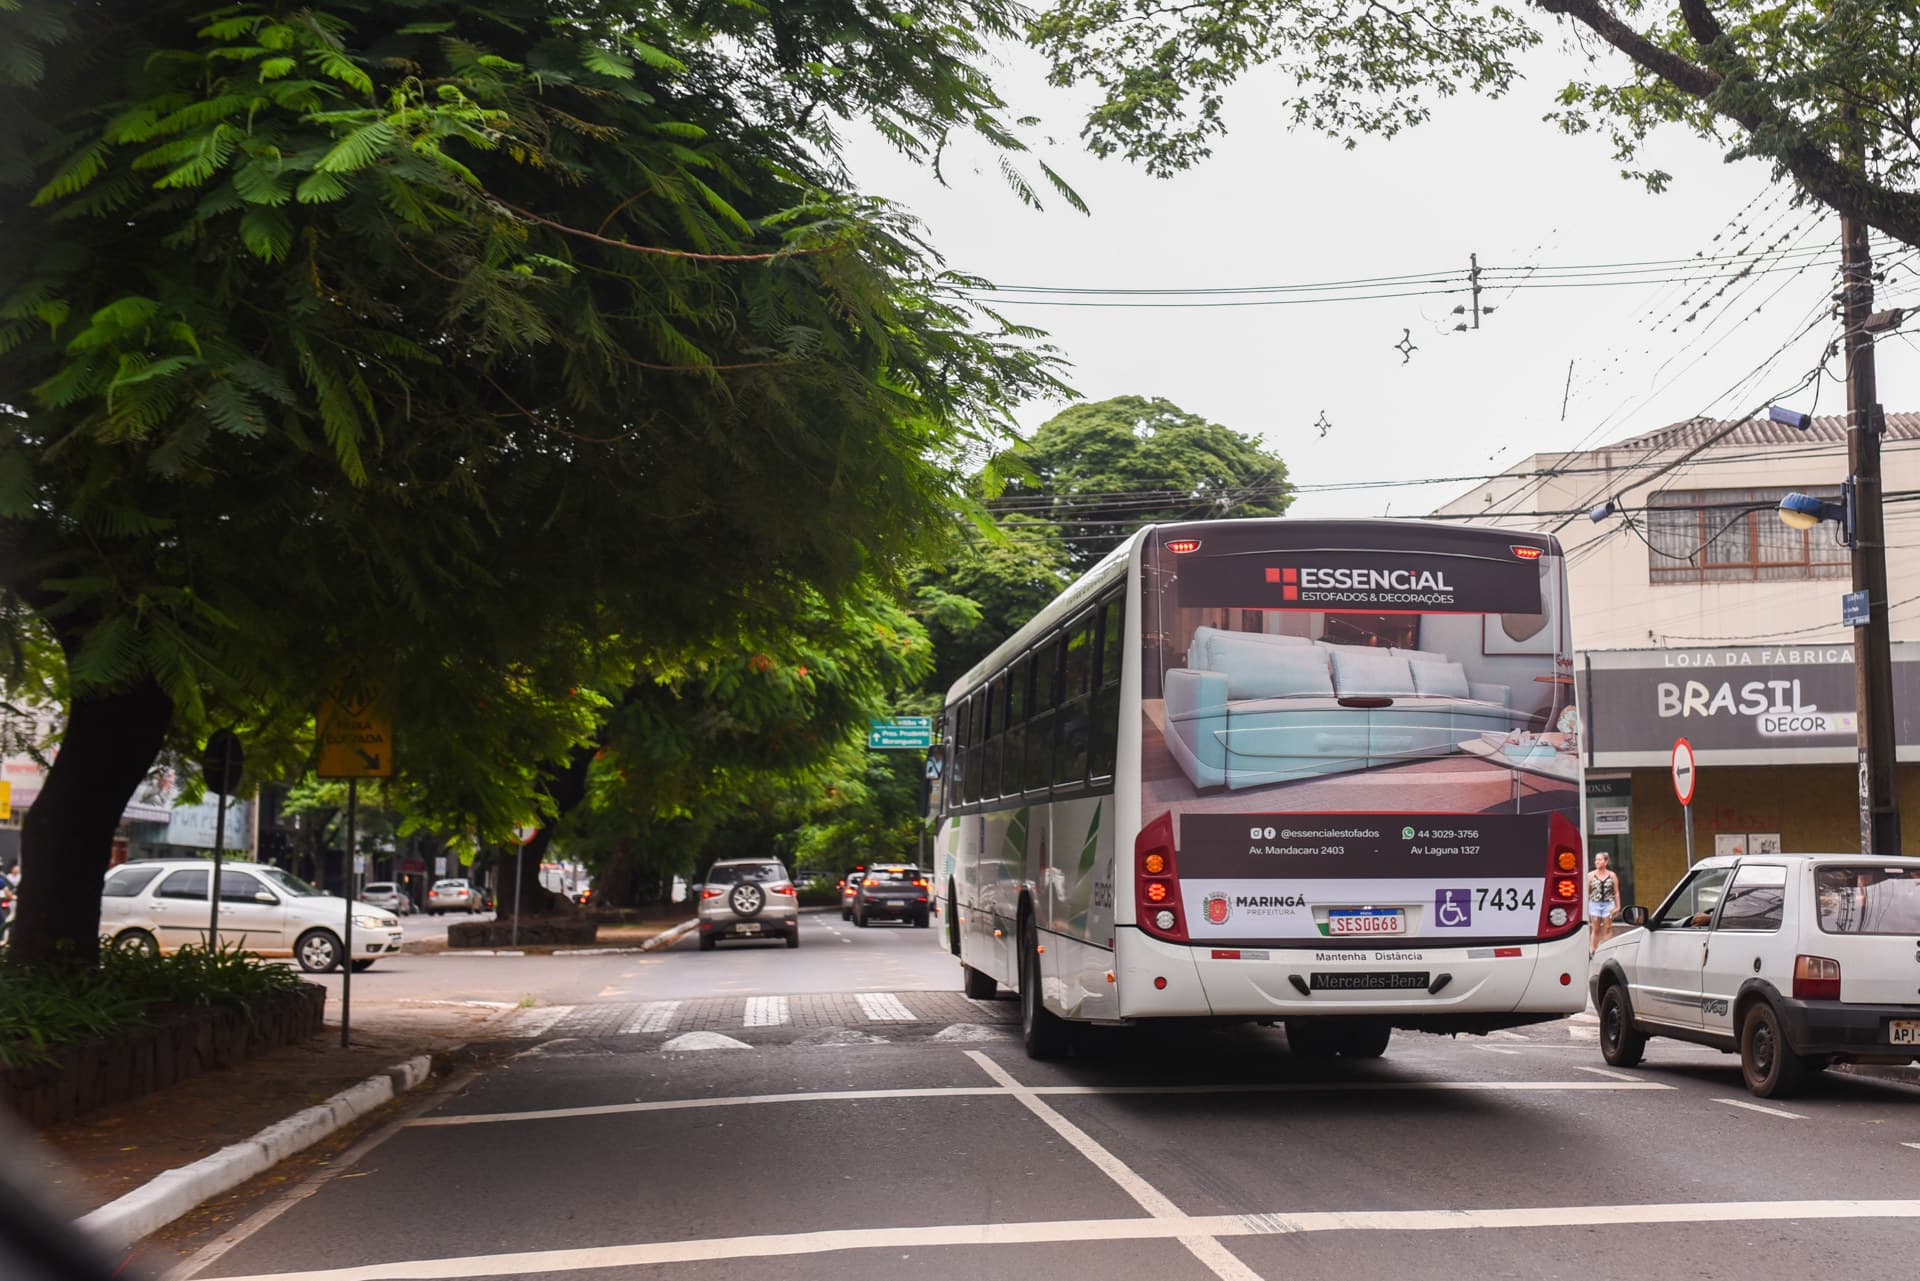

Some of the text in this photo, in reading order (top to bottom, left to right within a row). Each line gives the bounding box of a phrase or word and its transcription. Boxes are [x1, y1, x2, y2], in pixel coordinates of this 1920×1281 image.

[1302, 591, 1455, 605] ESTOFADOS & DECORAÇÕES
[1664, 648, 1856, 667] LOJA DA FÁBRICA
[1657, 679, 1818, 718] BRASIL
[1764, 717, 1827, 733] DECOR
[1281, 828, 1380, 839] @essencialestofados
[1417, 830, 1479, 839] 44 3029-3756
[1249, 846, 1263, 855] Av.
[1265, 846, 1319, 855] Mandacaru
[1320, 846, 1345, 855] 2403
[1411, 846, 1423, 855] Av
[1424, 846, 1458, 856] Laguna
[1460, 846, 1480, 855] 1327
[1236, 893, 1306, 907] MARINGÁ
[1475, 887, 1536, 911] 7434
[1247, 908, 1296, 916] PREFEITURA
[1315, 951, 1423, 961] Mantenha Distância
[1317, 975, 1425, 989] Mercedes-Benz
